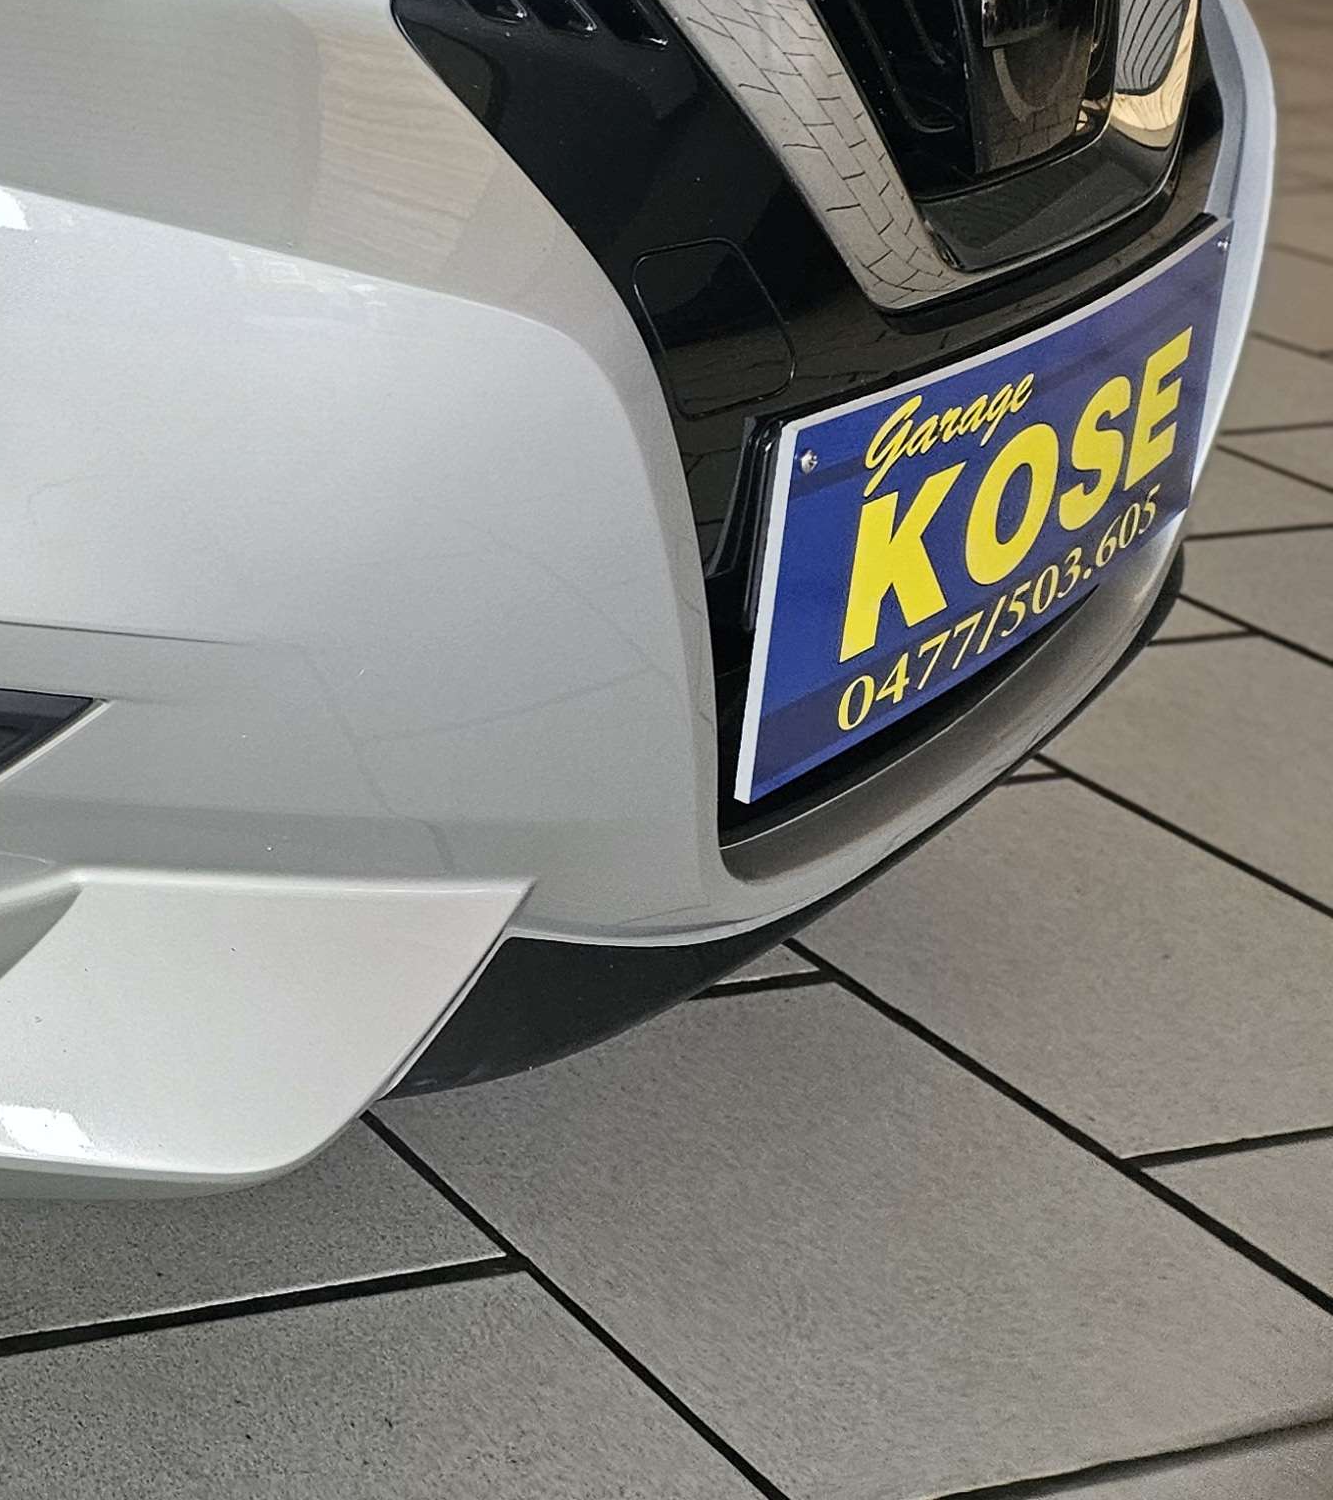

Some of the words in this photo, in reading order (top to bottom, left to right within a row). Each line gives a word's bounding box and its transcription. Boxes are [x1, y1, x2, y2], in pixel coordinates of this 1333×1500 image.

[839, 327, 1192, 663] KOSE
[865, 373, 1034, 496] Garage
[838, 486, 1160, 730] 0477/503.605
